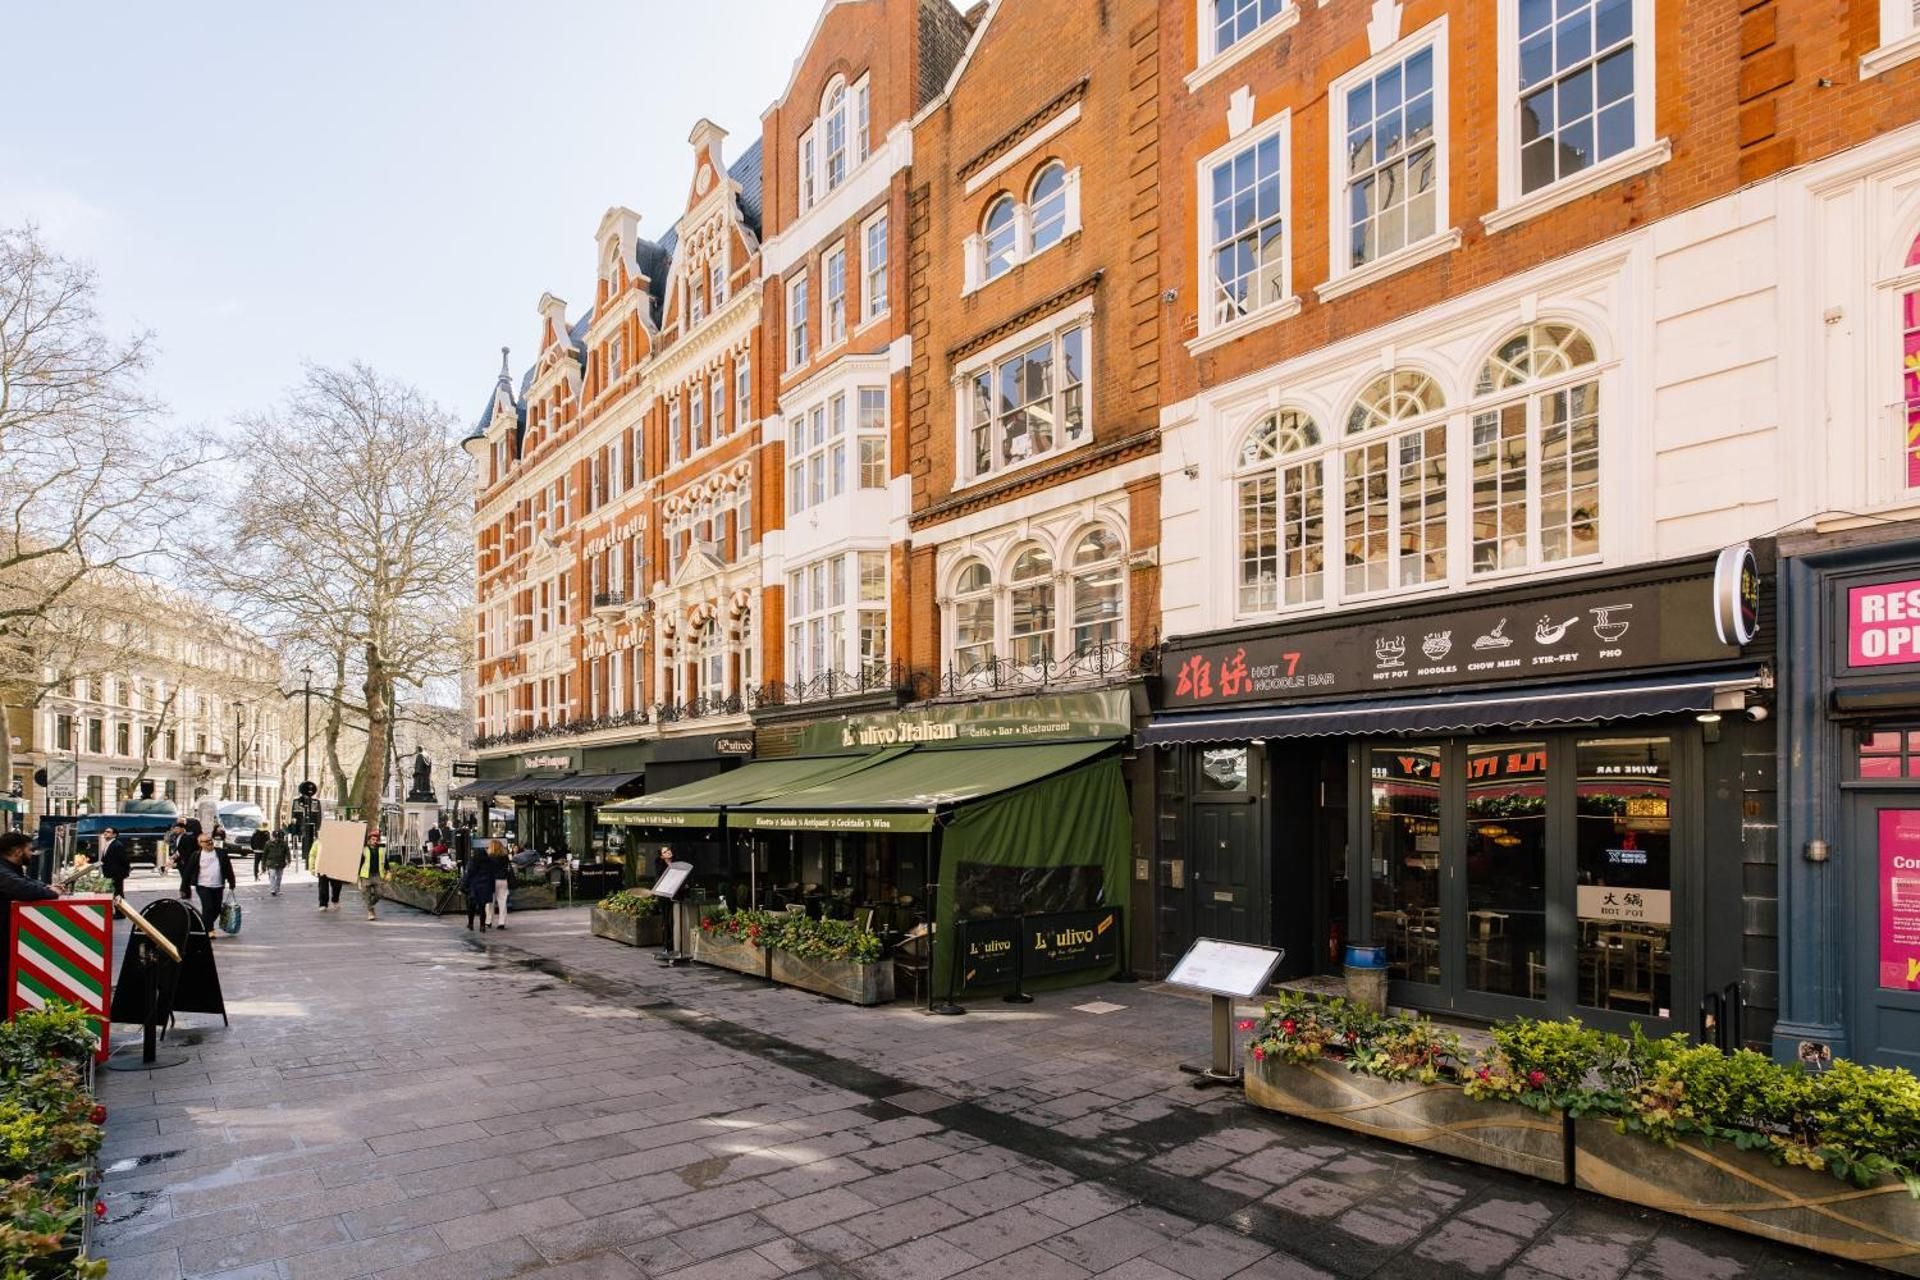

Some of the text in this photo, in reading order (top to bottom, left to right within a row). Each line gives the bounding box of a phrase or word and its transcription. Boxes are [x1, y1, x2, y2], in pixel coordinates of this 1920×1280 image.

[1861, 589, 1920, 623] RES
[1532, 652, 1579, 665] STIR-FRY
[1599, 648, 1622, 658] PHO
[1251, 652, 1301, 679] HOT 7
[1417, 665, 1458, 676] NOODLES
[1467, 658, 1521, 671] CHOW MEIN
[1373, 669, 1409, 681] HOT POT
[1254, 672, 1335, 692] NOODLE BAR
[898, 720, 959, 742] Italian
[999, 725, 1014, 736] Bar
[1021, 720, 1071, 735] Restaurant
[872, 818, 890, 828] Wine
[1601, 907, 1644, 917] HOT POT
